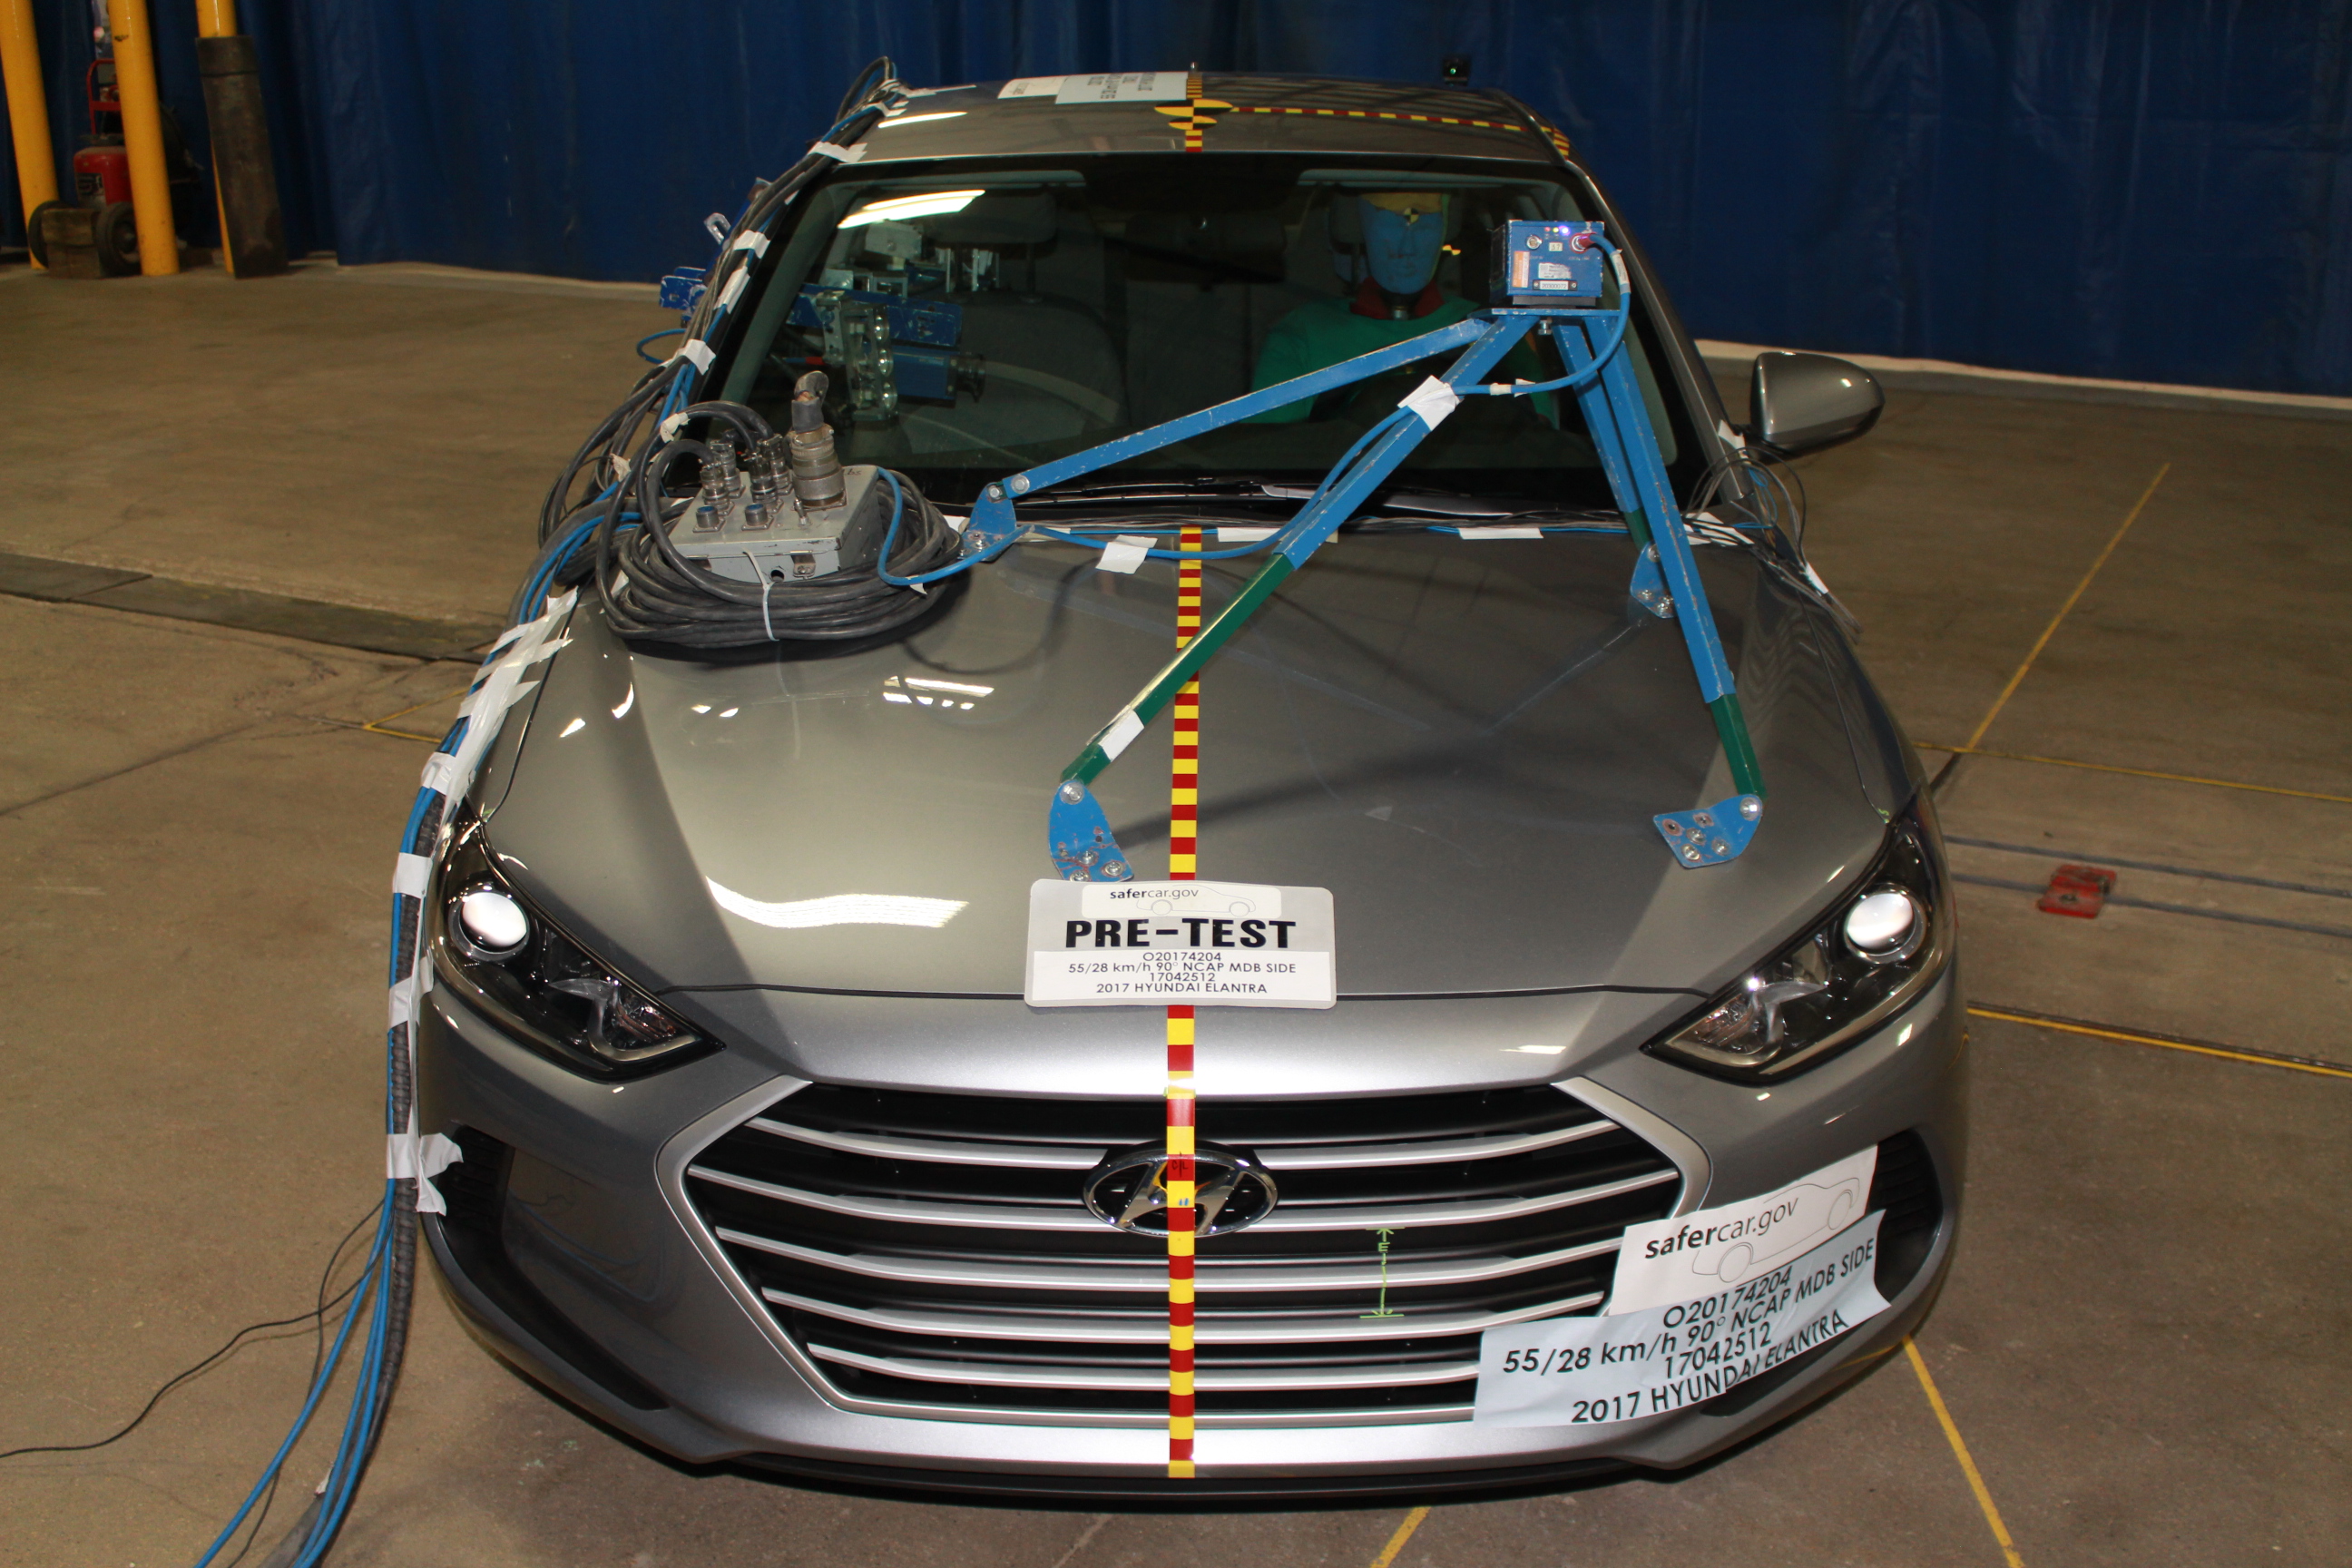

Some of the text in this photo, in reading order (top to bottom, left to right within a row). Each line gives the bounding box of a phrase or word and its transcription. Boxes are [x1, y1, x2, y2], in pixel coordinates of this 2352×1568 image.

[1110, 888, 1199, 900] safercar.gov
[1065, 917, 1297, 948] PRE-TEST
[1068, 962, 1296, 974] 55/28 km/h 90° NCAP MDB SIDE
[1150, 972, 1216, 982] 17042512
[1096, 983, 1268, 994] 2017 HYUNDAI ELANTRA
[1643, 1197, 1800, 1259] safercar.gov
[1503, 1237, 1875, 1376] 55/28 km/h 90° NCAP MDB SIDE
[1571, 1308, 1850, 1423] 2017 HYUNDAI ELANTRA
[1665, 1321, 1771, 1379] 17042512
